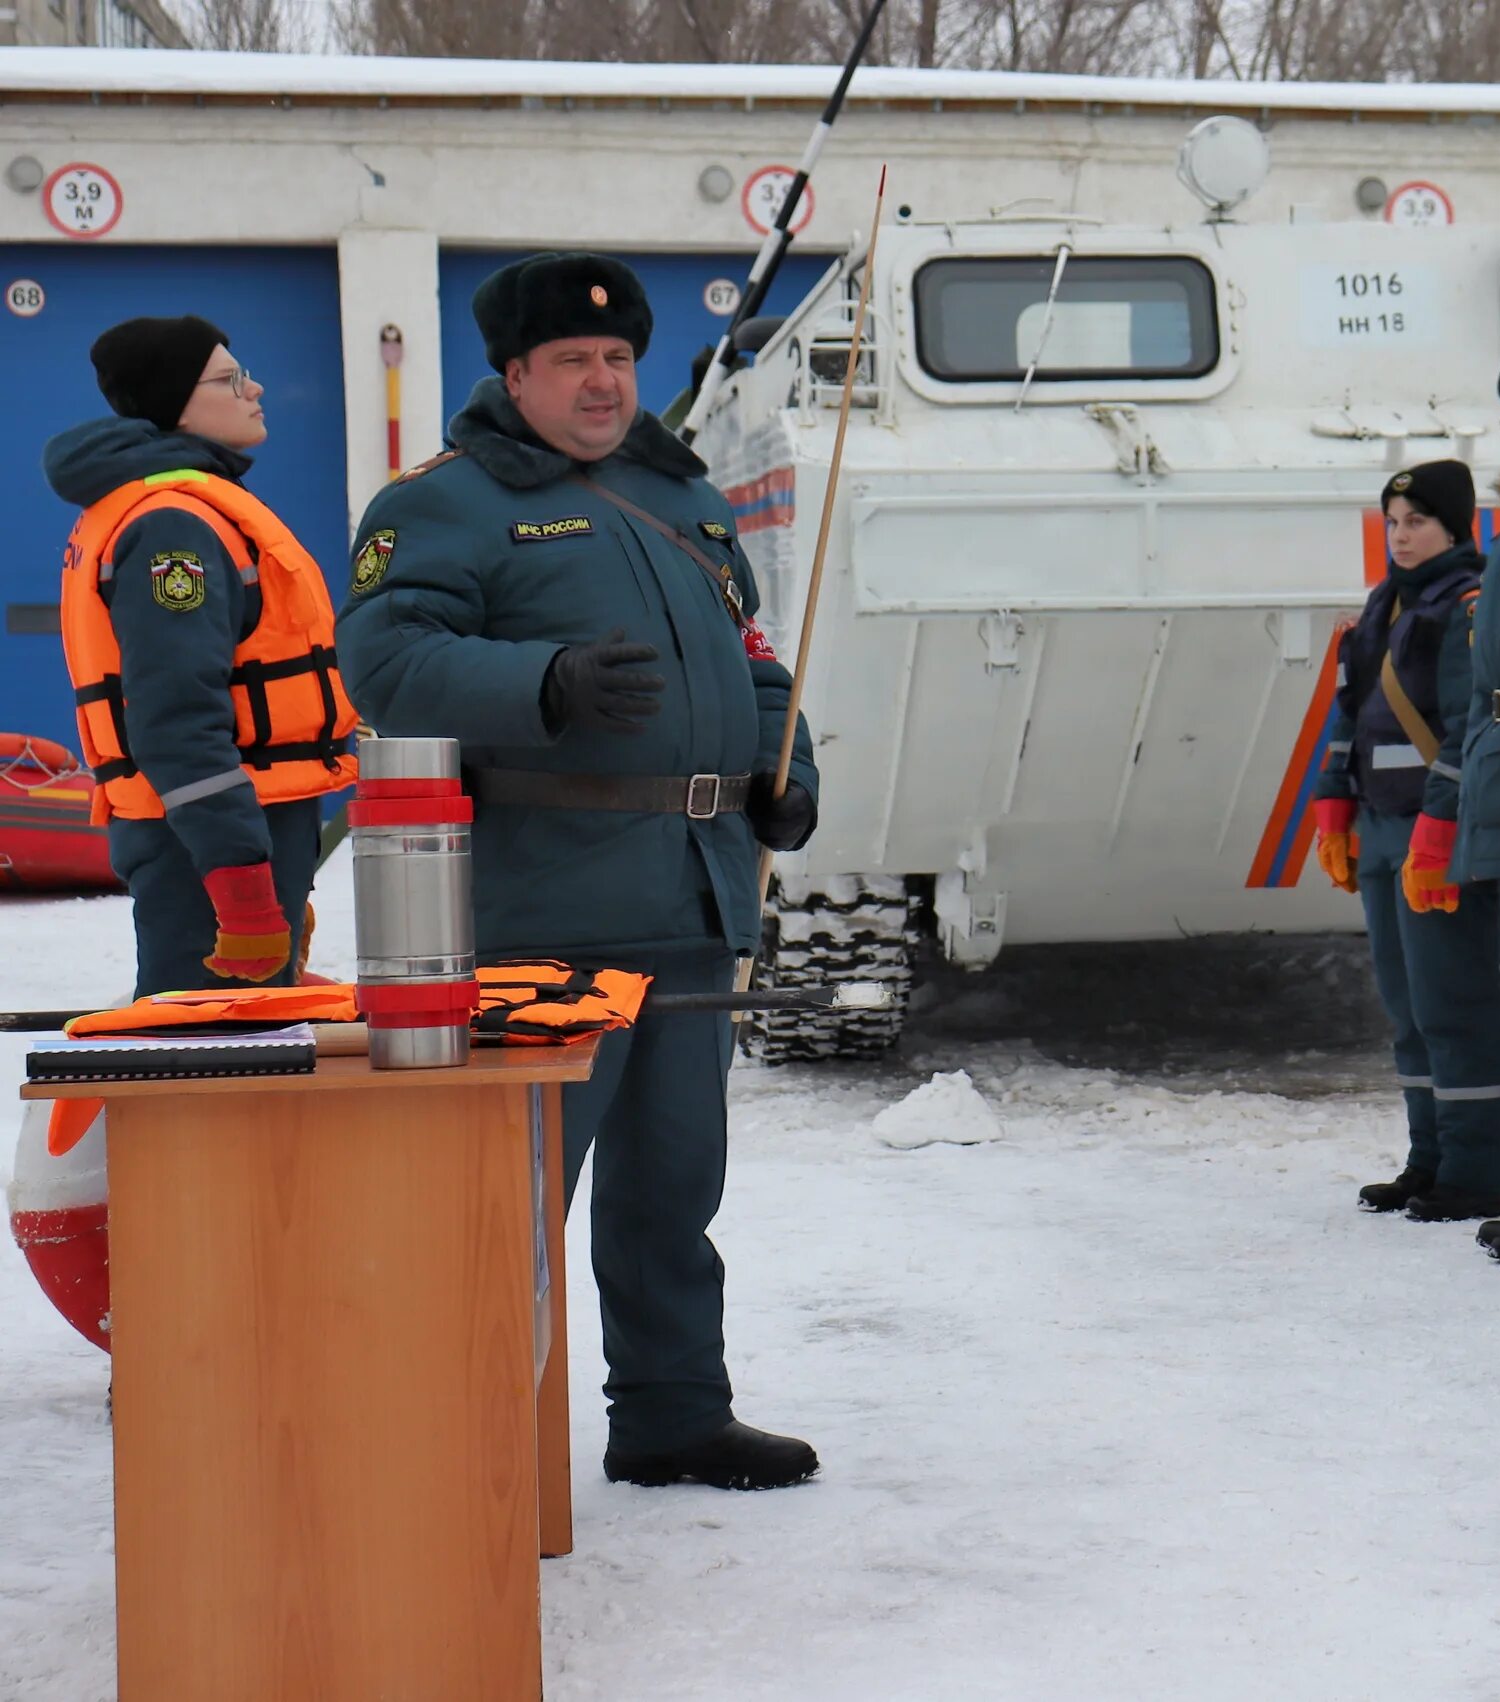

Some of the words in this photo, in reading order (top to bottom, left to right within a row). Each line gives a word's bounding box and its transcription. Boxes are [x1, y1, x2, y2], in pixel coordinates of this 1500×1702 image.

[65, 182, 101, 202] 3,9
[75, 206, 93, 219] М
[1336, 272, 1403, 297] 1016
[13, 287, 41, 307] 68
[710, 286, 734, 306] 67
[1377, 312, 1404, 333] 18
[517, 523, 542, 536] МЧС
[543, 518, 590, 535] РОССИИ
